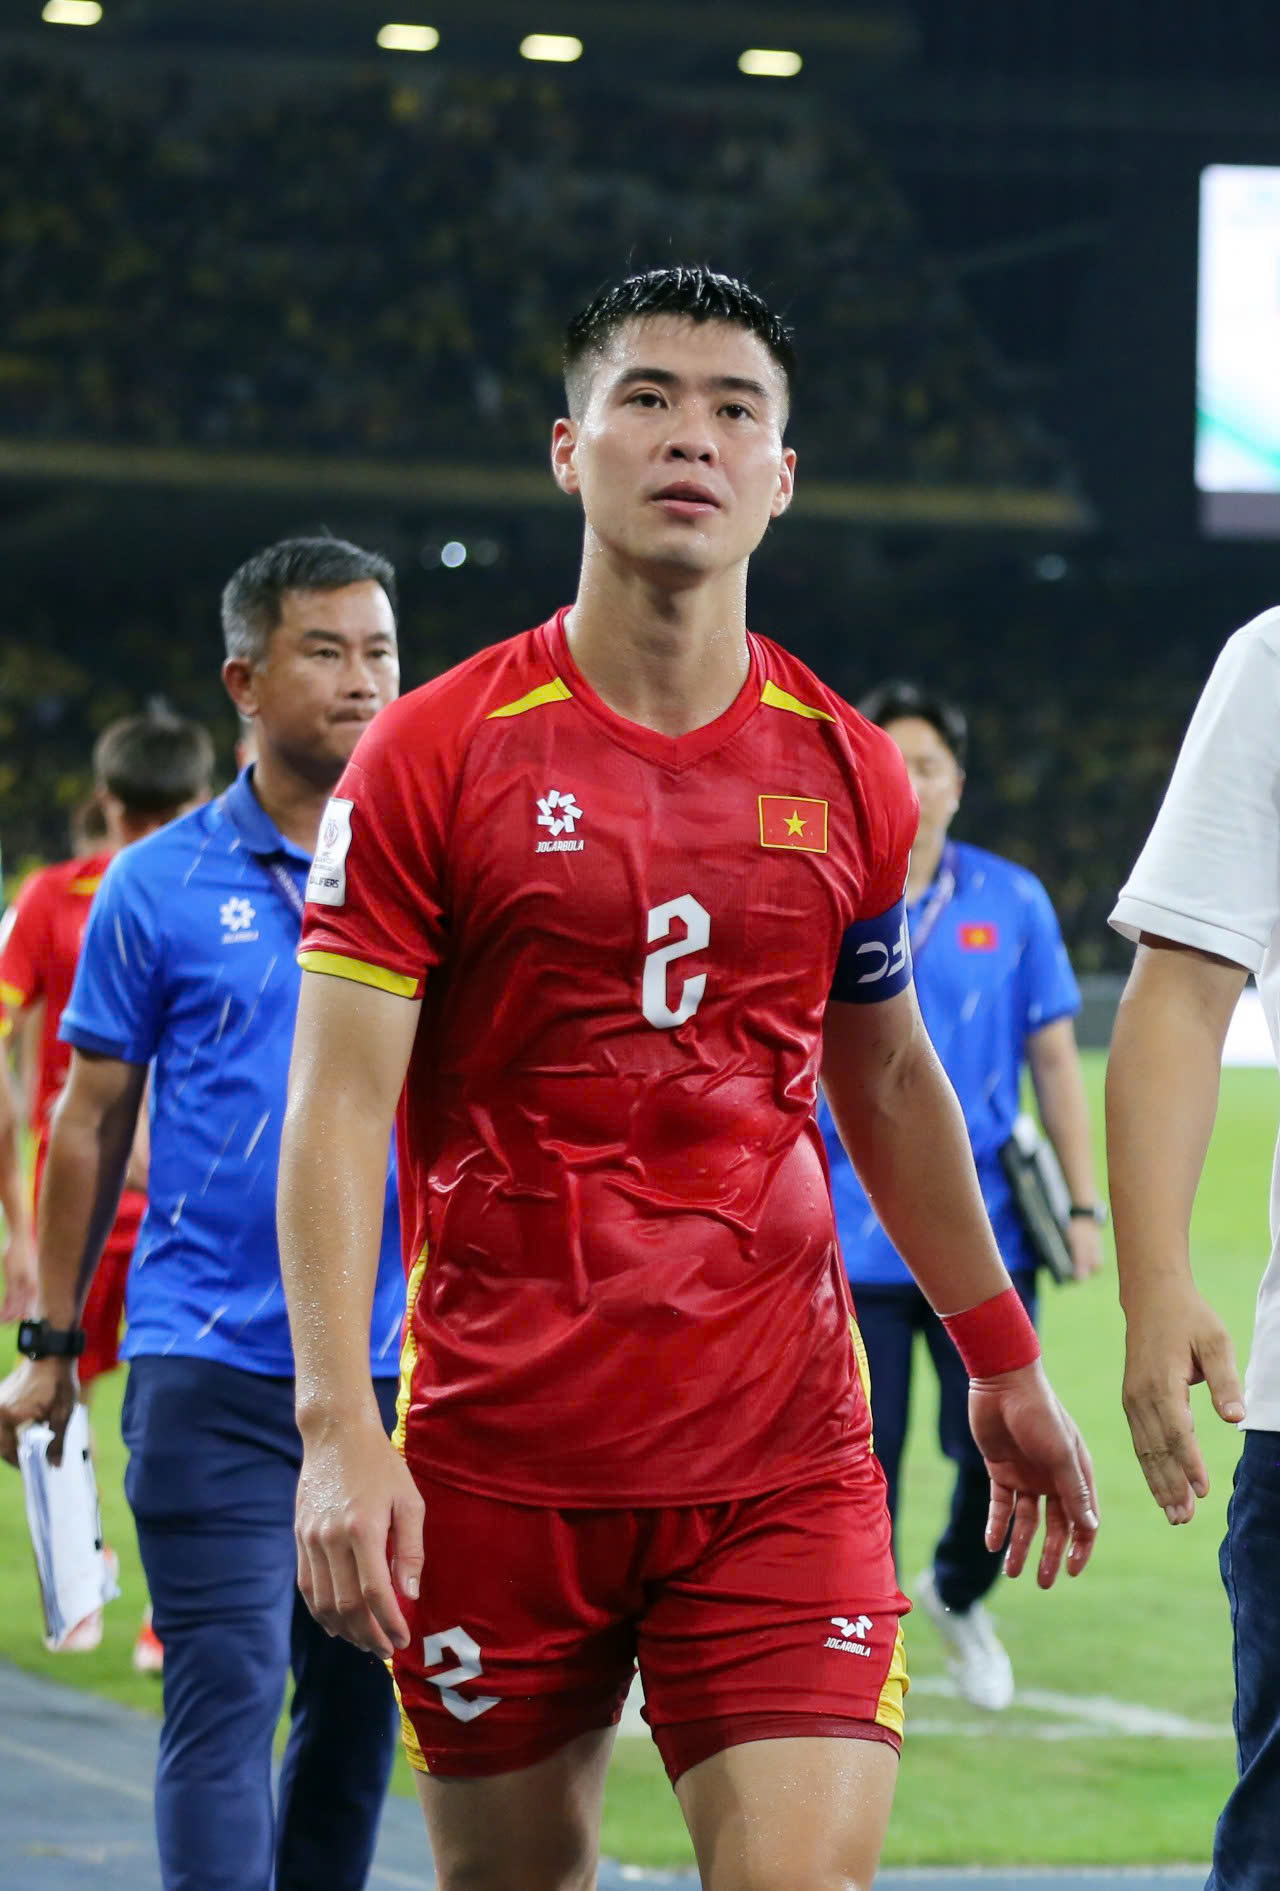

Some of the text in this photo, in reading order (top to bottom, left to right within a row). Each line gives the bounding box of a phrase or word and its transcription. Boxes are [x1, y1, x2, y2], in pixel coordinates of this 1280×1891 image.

[536, 840, 584, 853] JOGARBOLA
[642, 894, 710, 1029] 2
[424, 1625, 502, 1723] 2
[823, 1636, 871, 1658] JOGARBOLA
